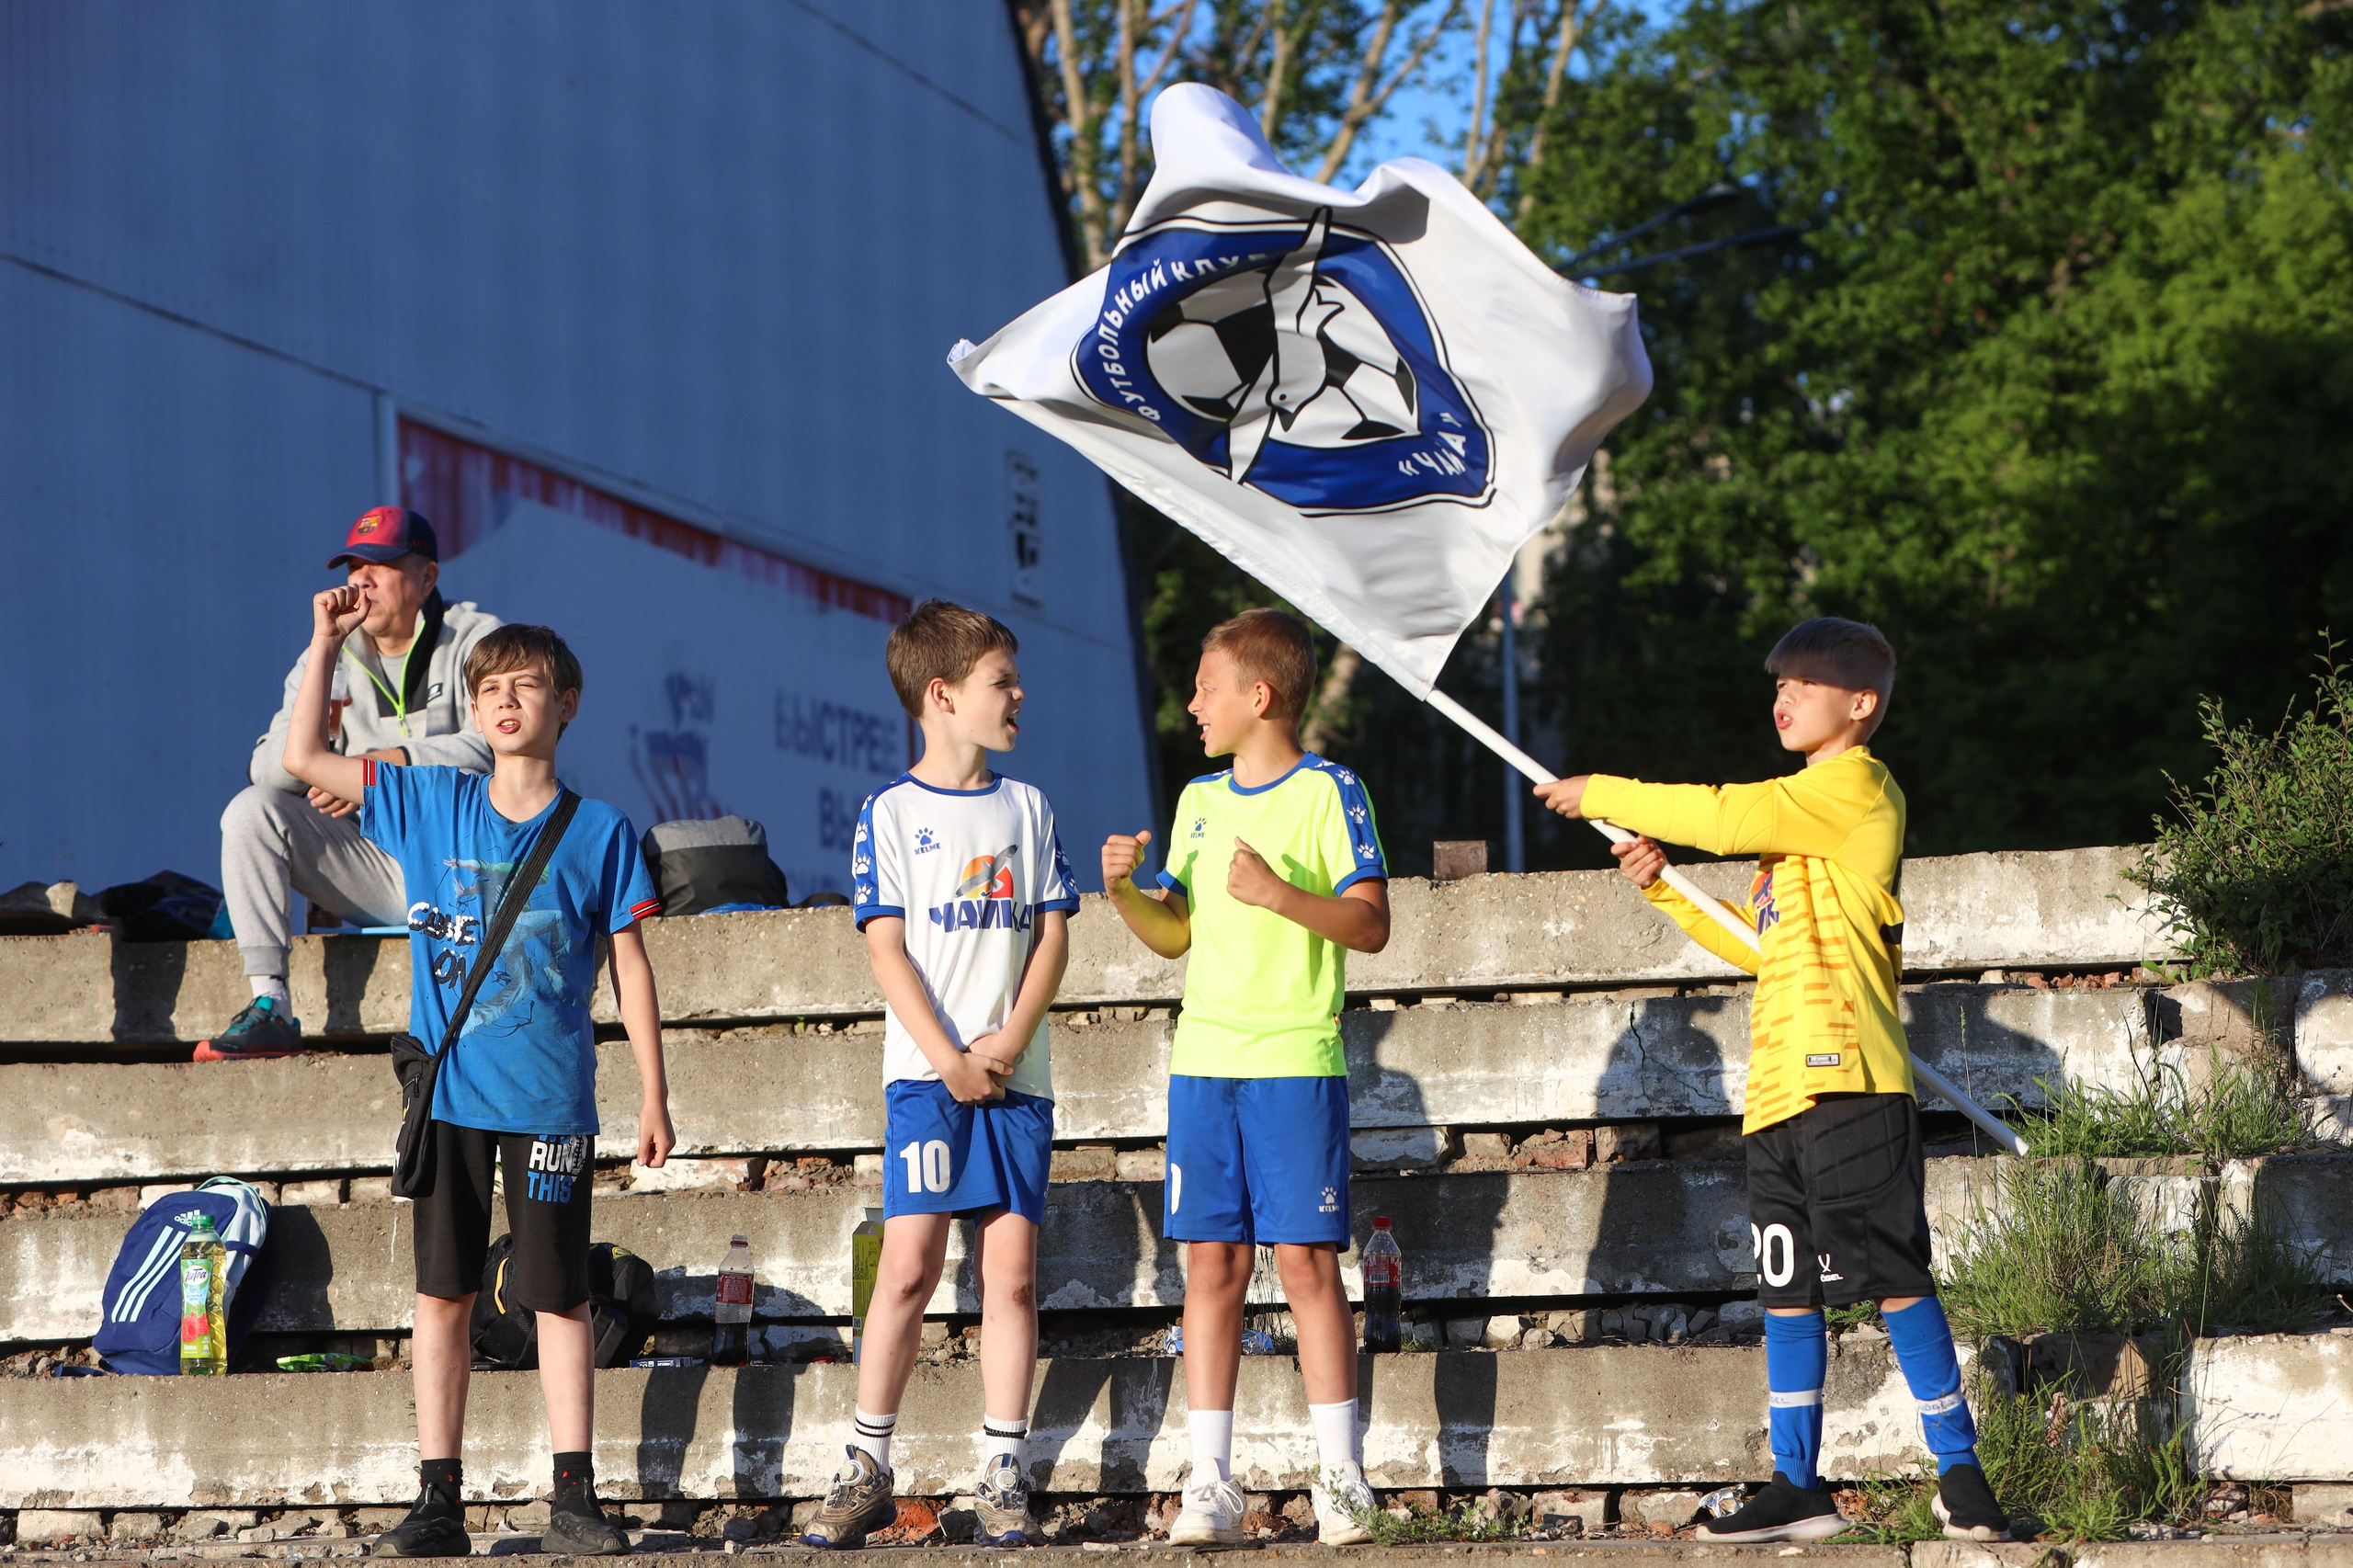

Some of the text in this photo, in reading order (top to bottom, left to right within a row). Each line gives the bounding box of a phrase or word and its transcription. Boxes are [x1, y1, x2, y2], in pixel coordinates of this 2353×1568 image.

[1097, 258, 1168, 422] ФУТБОЛЬНЫЙ
[915, 843, 941, 855] KELME
[529, 1141, 574, 1173] RUN
[899, 1139, 950, 1193] 10
[528, 1170, 574, 1203] THIS
